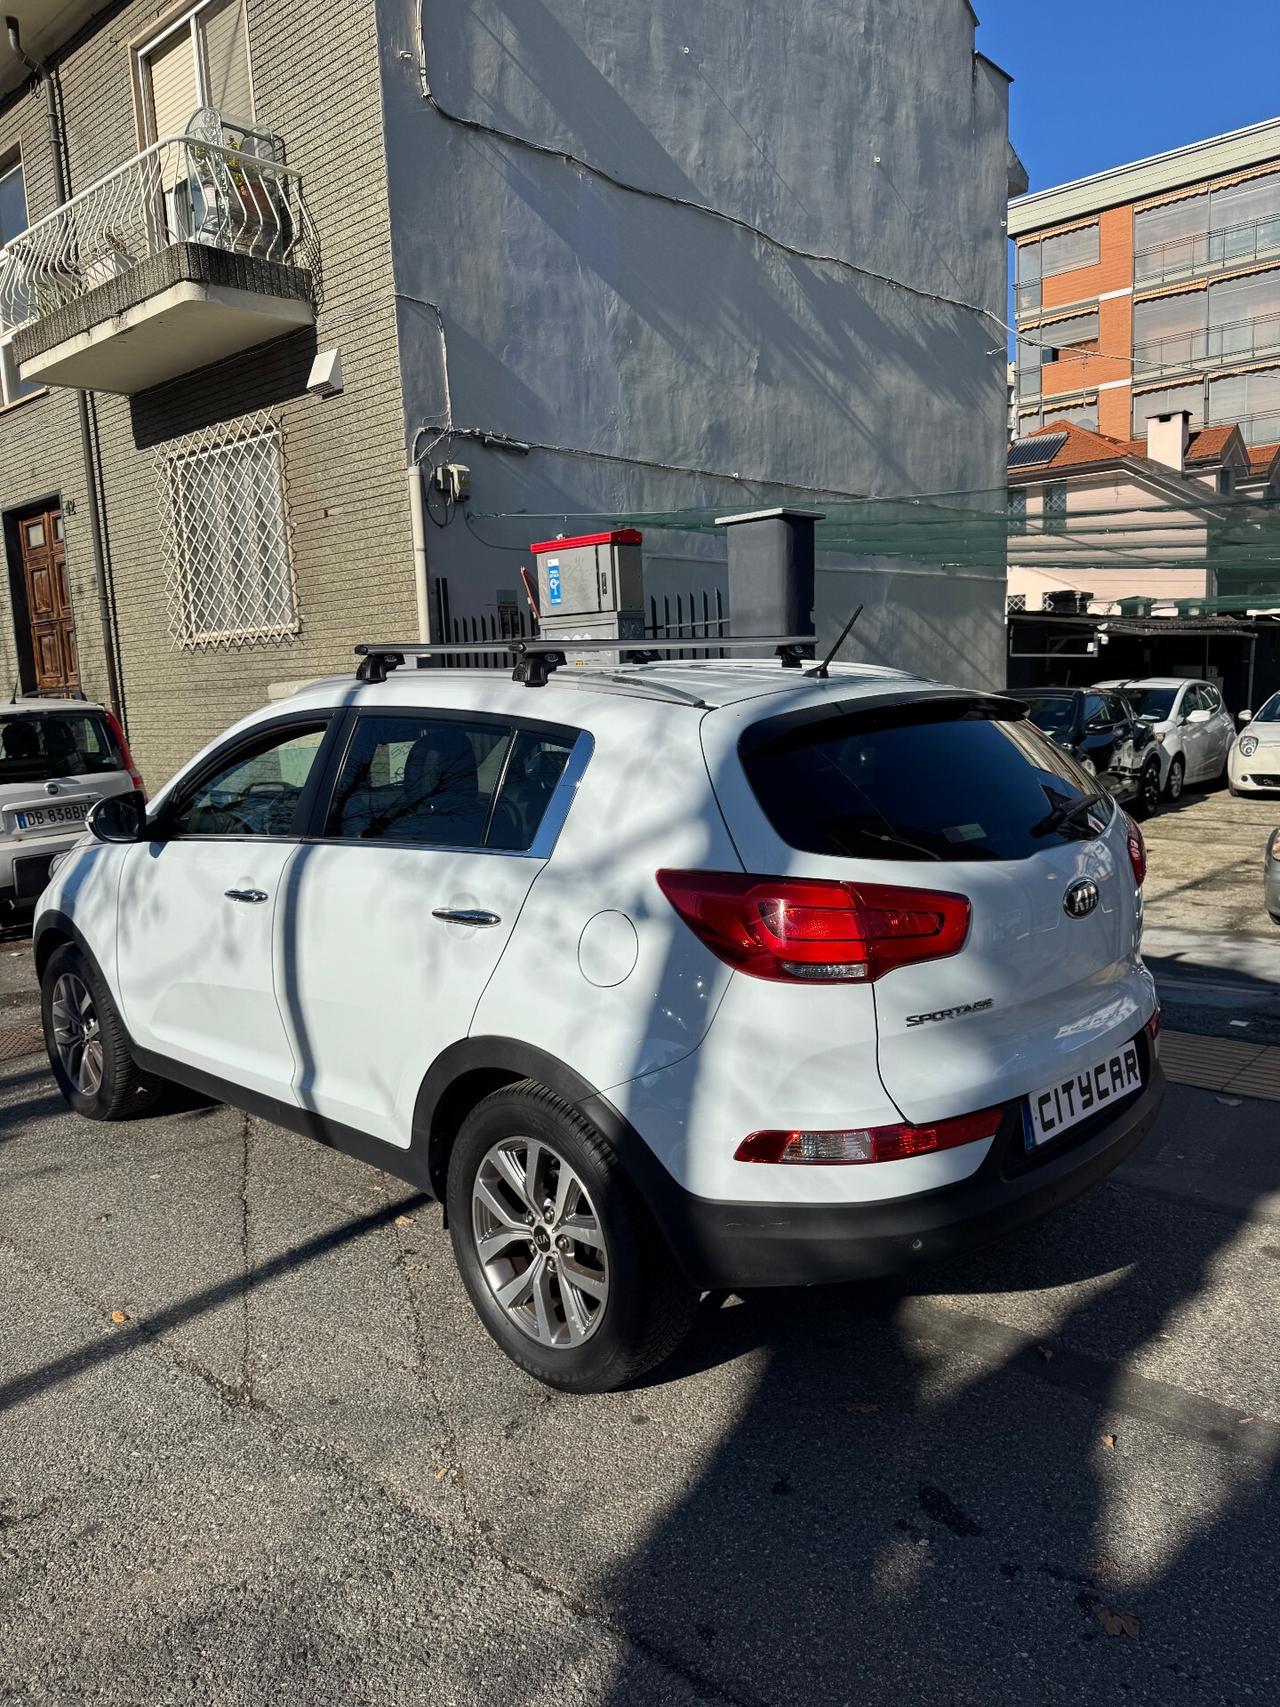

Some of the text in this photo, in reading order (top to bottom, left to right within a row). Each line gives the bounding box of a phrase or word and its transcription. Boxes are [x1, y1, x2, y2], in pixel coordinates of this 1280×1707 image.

[26, 804, 88, 826] DB 838BH
[905, 998, 993, 1027] SPORTAGE
[1038, 1049, 1139, 1132] CITYCAR
[535, 1234, 549, 1245] KIA
